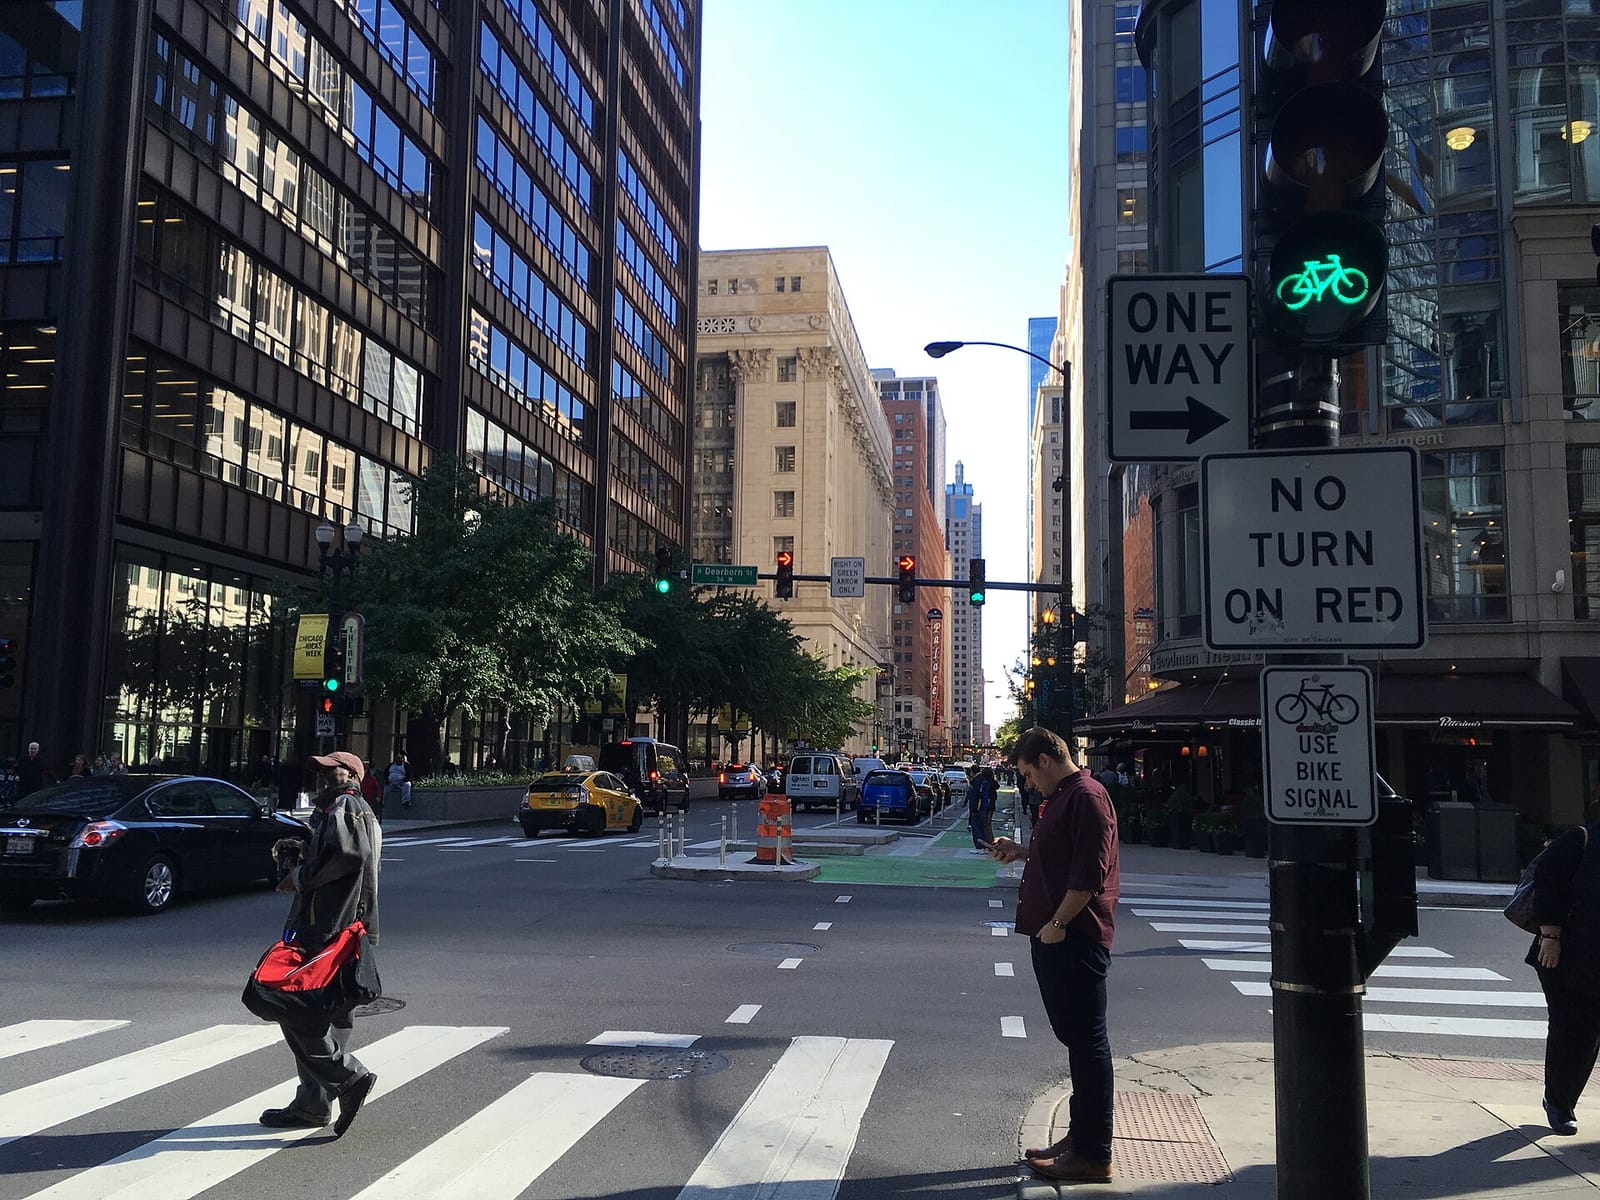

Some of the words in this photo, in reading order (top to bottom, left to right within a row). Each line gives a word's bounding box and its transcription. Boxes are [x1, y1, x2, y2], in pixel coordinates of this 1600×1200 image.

[1127, 291, 1233, 333] ONE
[1125, 343, 1236, 385] WAY
[1271, 476, 1347, 513] NO
[1249, 530, 1374, 568] TURN
[705, 567, 743, 577] Dearborn
[833, 560, 851, 568] RIGHT
[838, 569, 858, 577] GREEN
[839, 586, 856, 594] ONLY
[1225, 587, 1283, 624] ON
[1316, 587, 1403, 623] RED
[346, 626, 354, 681] THEATRE
[932, 622, 941, 697] Palace
[1156, 651, 1199, 669] Goodman
[1229, 718, 1256, 726] Classic
[1299, 735, 1338, 754] USE
[1297, 762, 1343, 781] BIKE
[1285, 788, 1358, 808] SIGNAL
